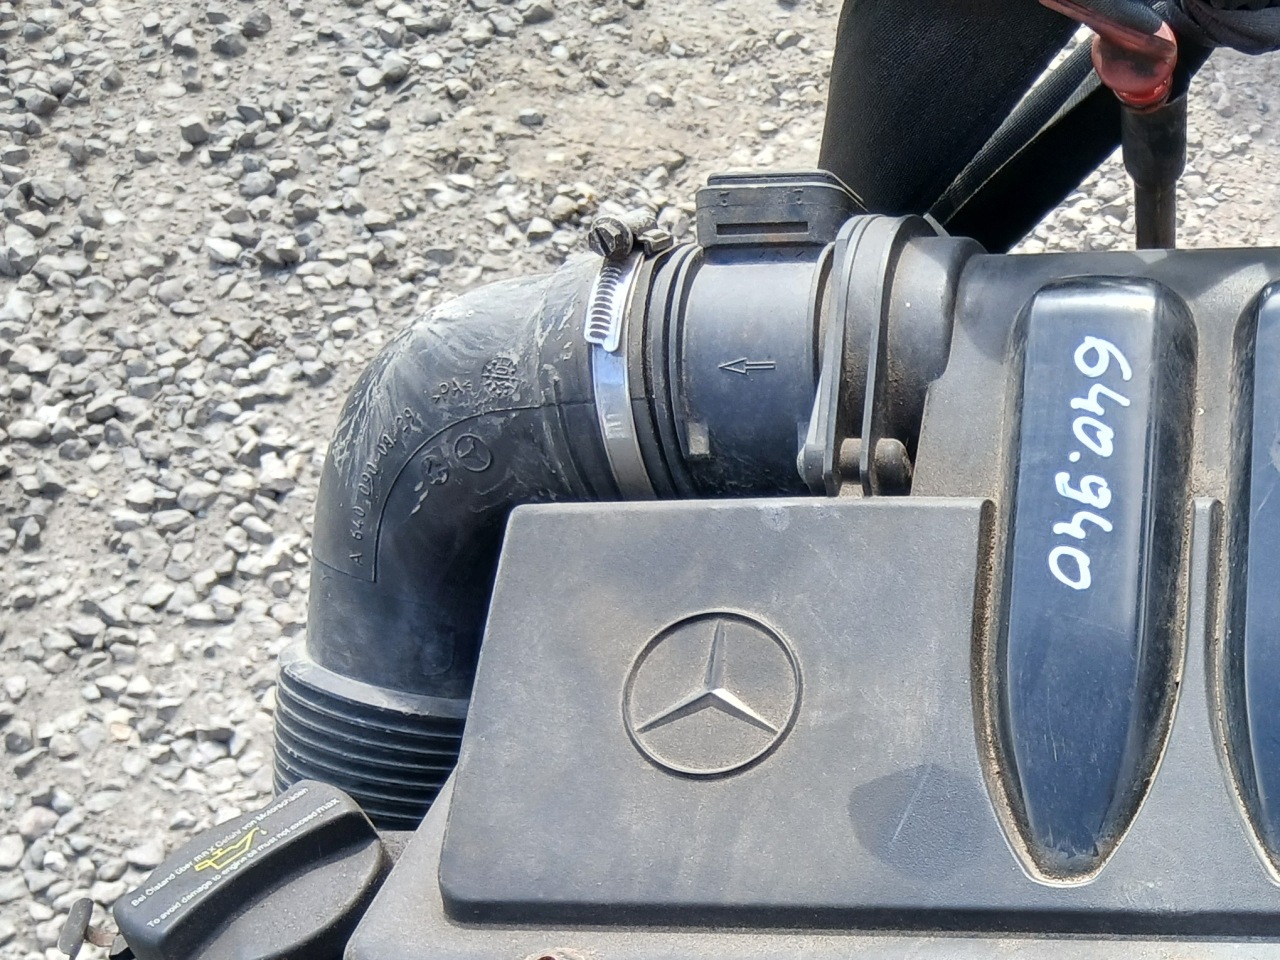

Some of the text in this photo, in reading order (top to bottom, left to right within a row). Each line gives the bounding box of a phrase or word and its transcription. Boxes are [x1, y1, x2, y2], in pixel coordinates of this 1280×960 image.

[1048, 335, 1133, 590] 640.940
[131, 895, 147, 907] Bei
[145, 872, 176, 896] Ölstand
[175, 861, 194, 876] über
[215, 829, 242, 848] Gefahr
[242, 819, 257, 831] von
[255, 787, 309, 822] Motorschäden
[147, 798, 340, 927] To avoid damage to engine oil must not exceed max
